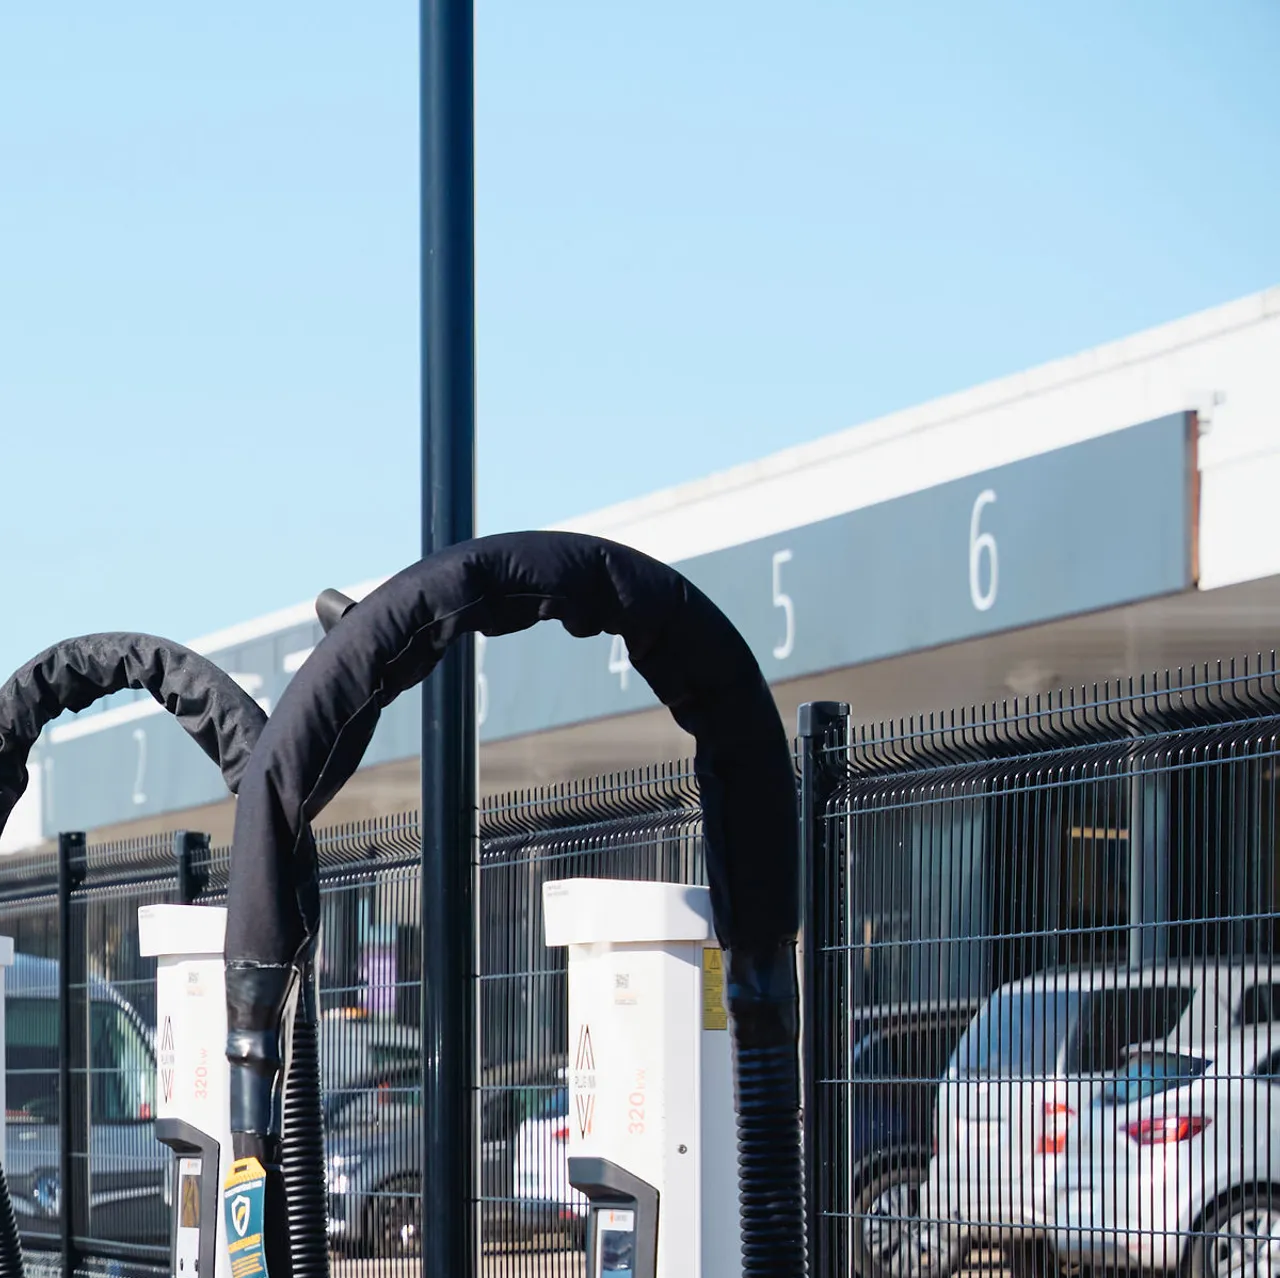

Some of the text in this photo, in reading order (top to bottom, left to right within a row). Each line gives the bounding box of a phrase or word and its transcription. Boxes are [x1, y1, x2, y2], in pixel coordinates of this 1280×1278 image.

[771, 549, 796, 661] 5
[969, 488, 1000, 612] 6
[607, 634, 631, 692] 4
